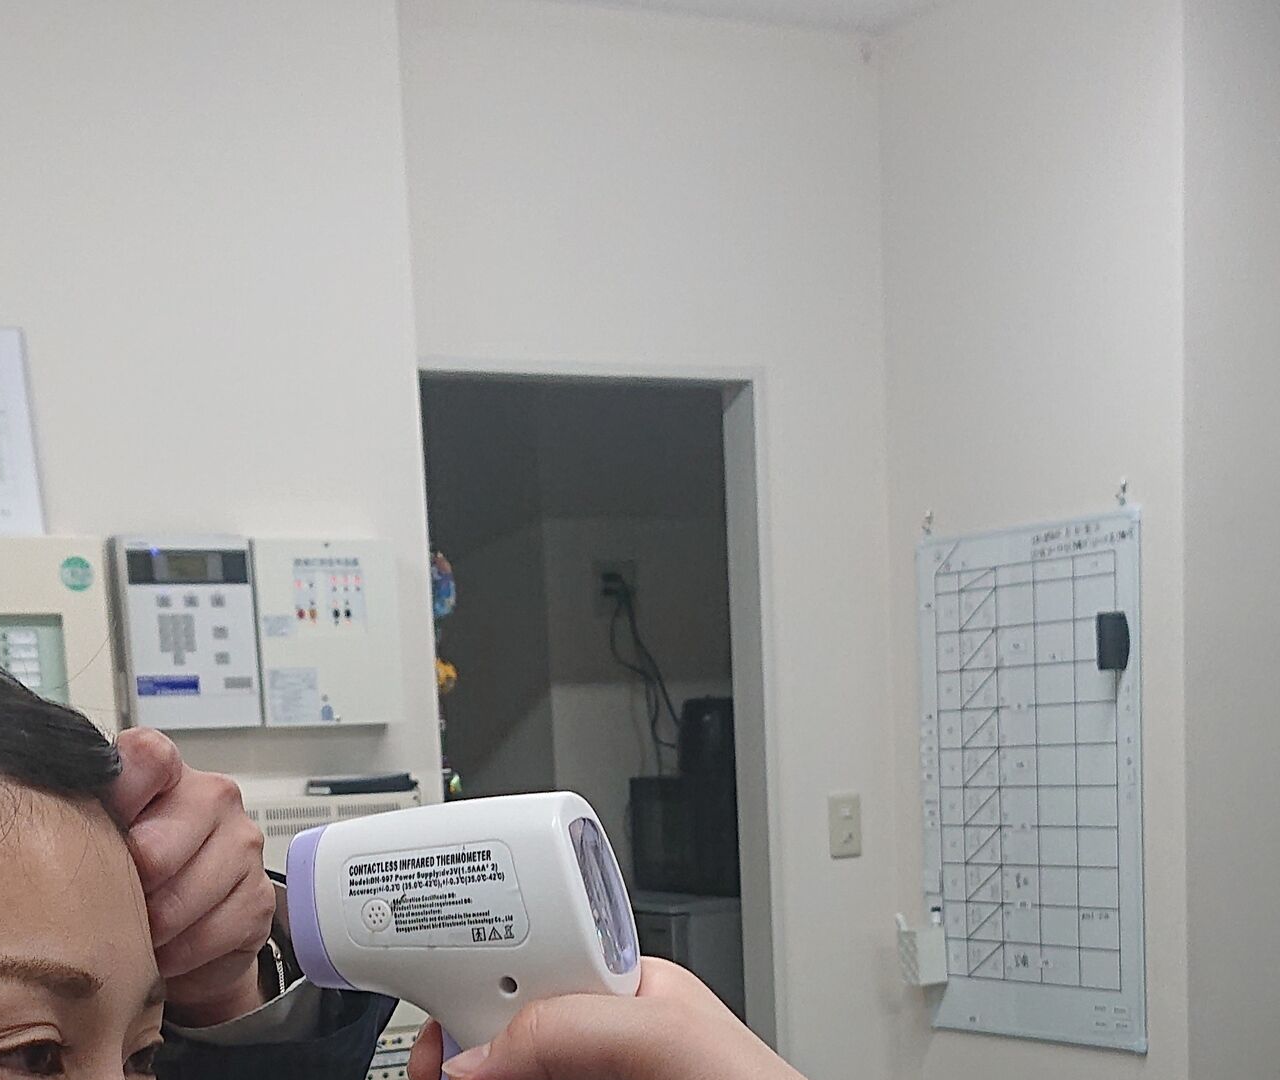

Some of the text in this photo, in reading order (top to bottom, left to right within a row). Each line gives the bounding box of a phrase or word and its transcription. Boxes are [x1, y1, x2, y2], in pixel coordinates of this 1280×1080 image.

[349, 850, 492, 877] CONTACTLESS INFRARED THERMOMETER
[394, 873, 416, 881] Power
